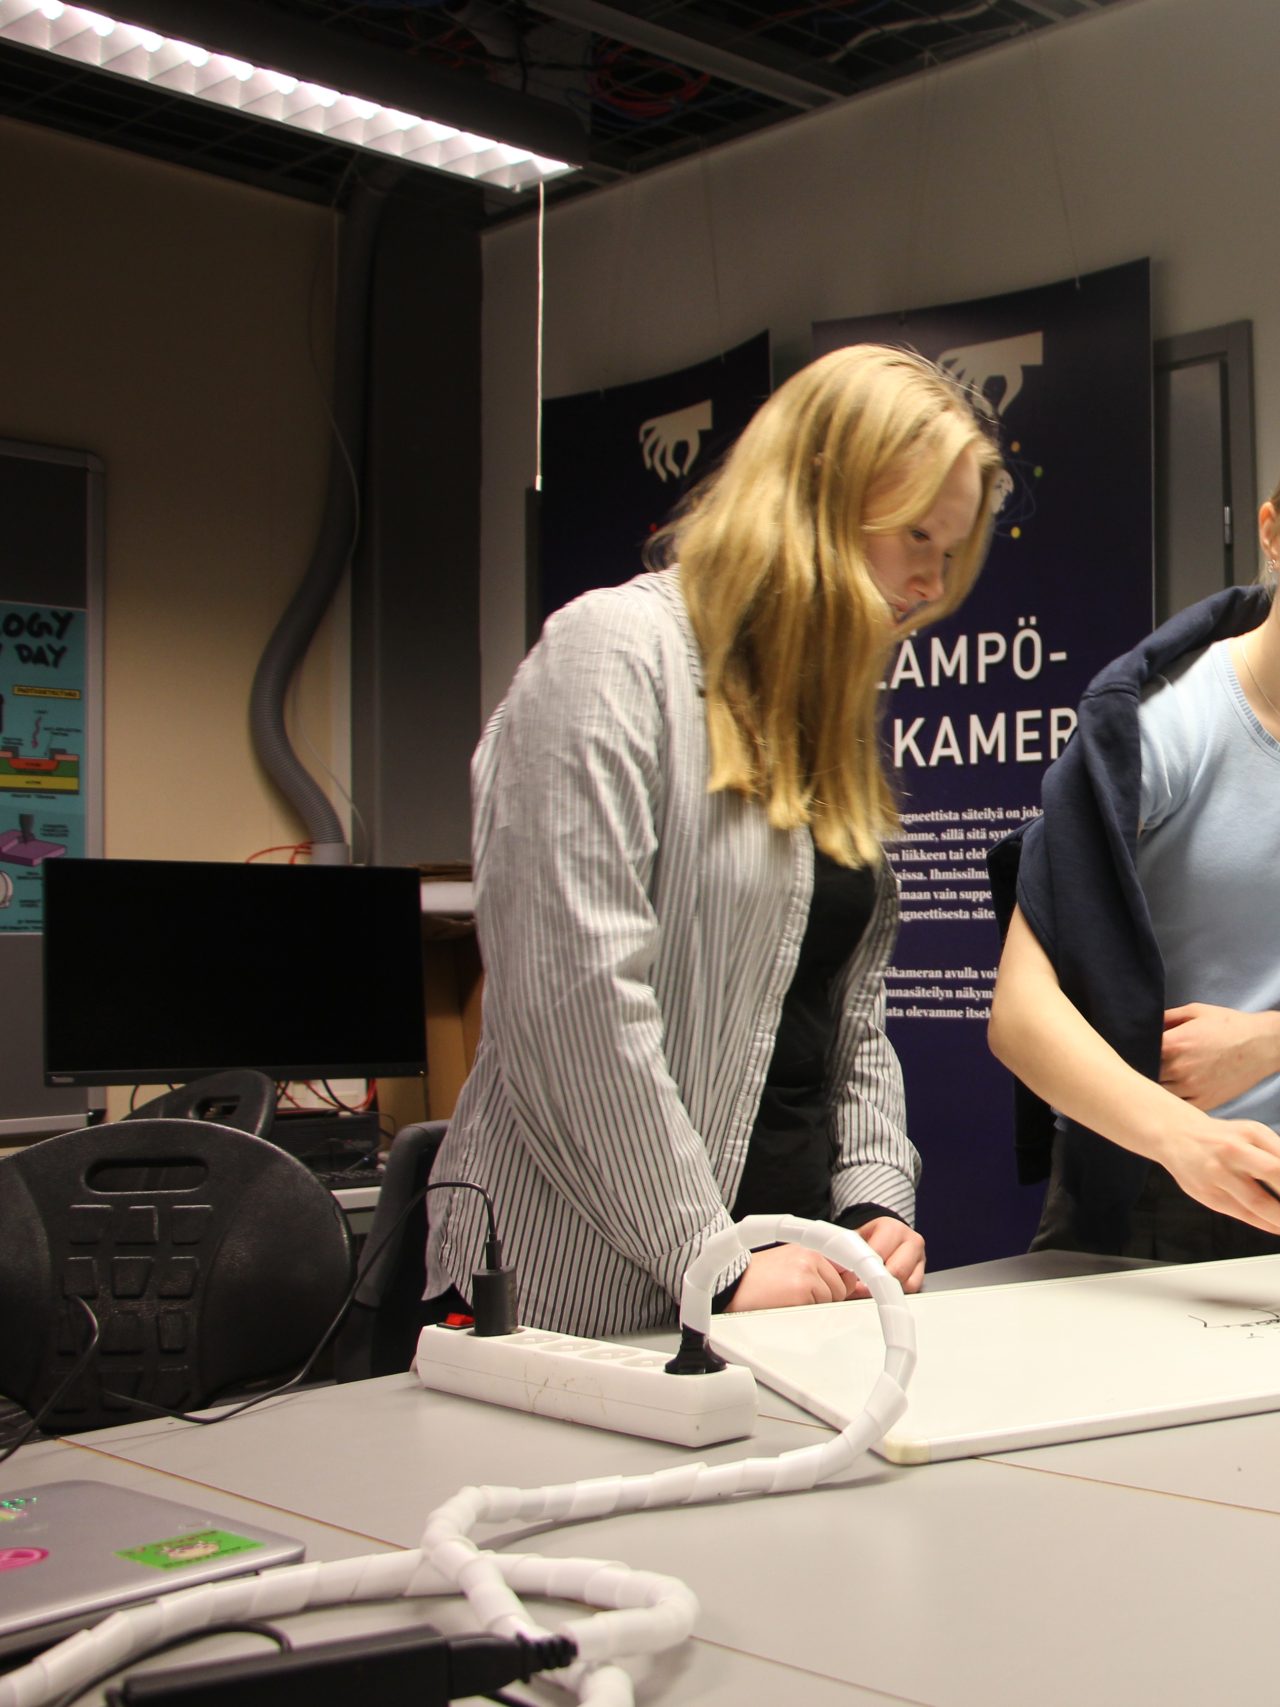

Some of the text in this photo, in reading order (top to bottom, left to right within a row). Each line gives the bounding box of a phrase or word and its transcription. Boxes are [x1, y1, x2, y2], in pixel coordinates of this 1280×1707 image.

[0, 611, 75, 640] OGY
[14, 643, 67, 669] DAY
[876, 616, 1067, 690] ÄMPÖ-
[961, 808, 1004, 822] säteilyä
[1006, 810, 1020, 819] on
[940, 828, 964, 841] sillä
[966, 828, 986, 840] sitä
[901, 849, 946, 861] liikkeen
[948, 848, 963, 860] tai
[933, 888, 957, 900] vain
[972, 908, 996, 920] säte
[944, 966, 978, 979] avulla
[886, 986, 953, 1000] unasäteilyn
[906, 1005, 963, 1017] olevamme
